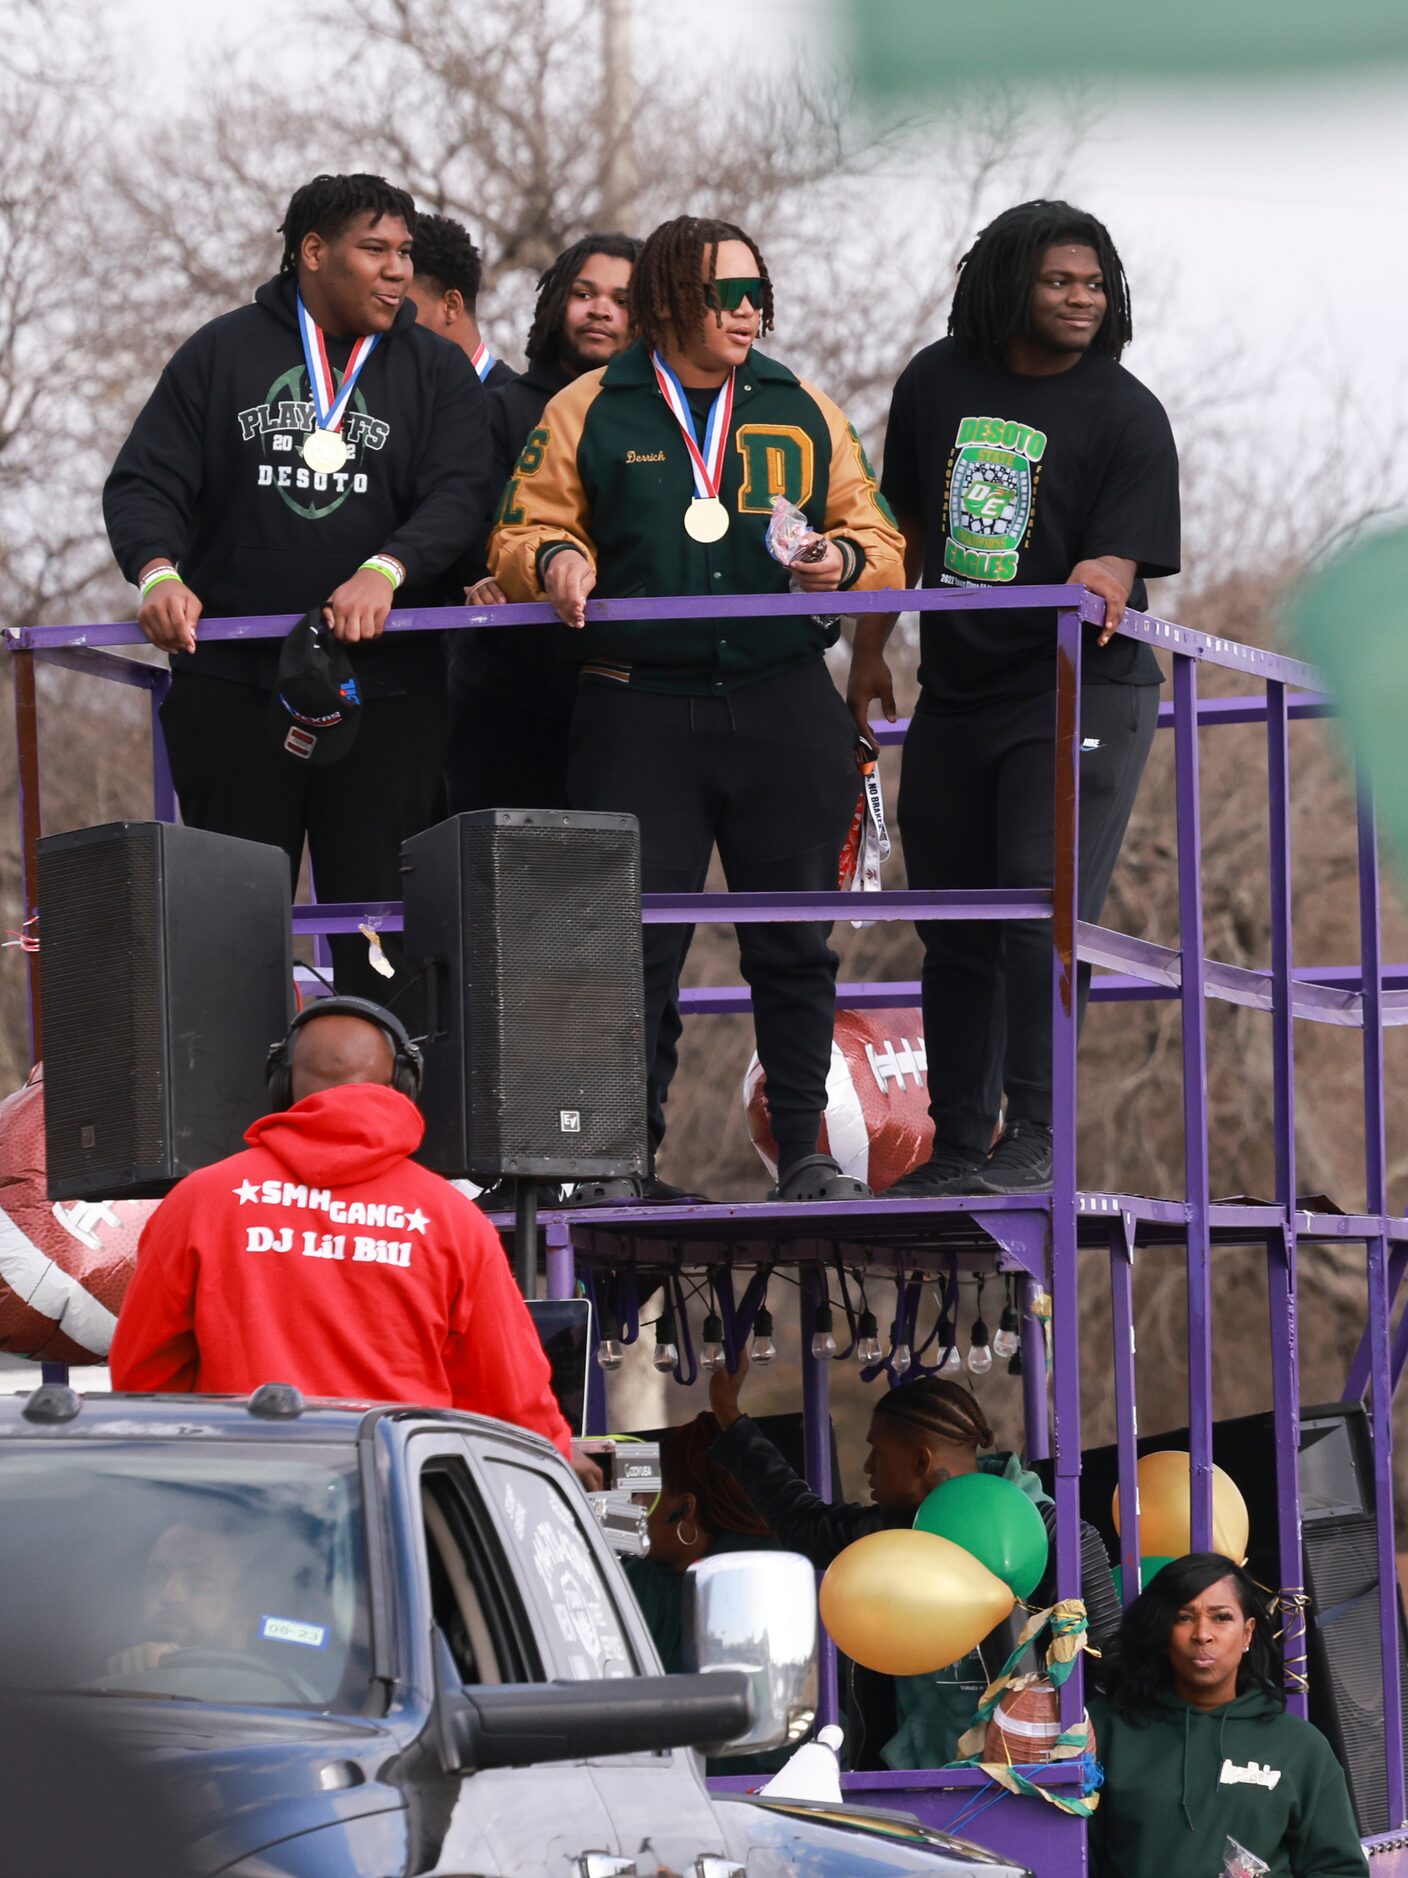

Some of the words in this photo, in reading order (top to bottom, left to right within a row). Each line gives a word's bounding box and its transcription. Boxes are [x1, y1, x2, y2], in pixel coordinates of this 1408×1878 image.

[238, 401, 390, 450] PLAYFS
[955, 417, 1047, 462] DESOTO
[257, 464, 368, 493] DESOTO
[625, 450, 666, 464] Derrick
[944, 537, 1019, 582] EAGLES
[245, 1226, 295, 1253] DJ
[302, 1231, 346, 1260] Lil
[352, 1236, 412, 1267] Bill
